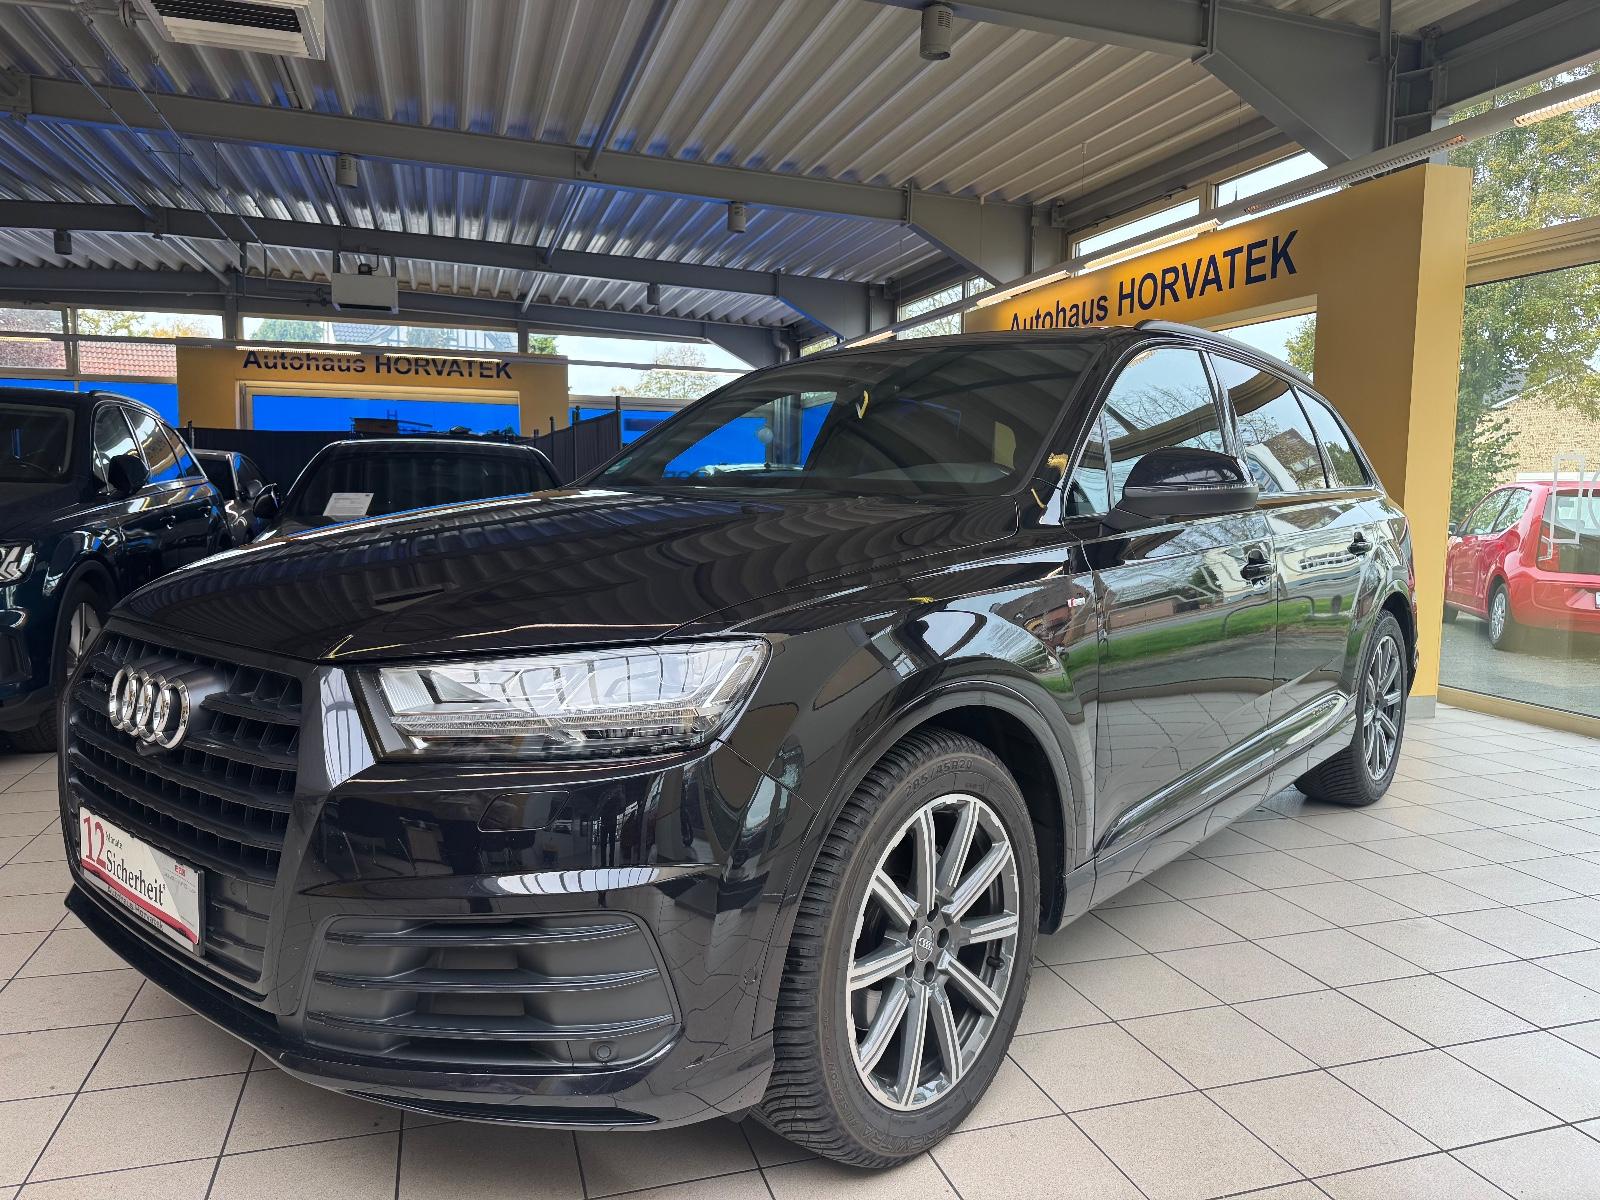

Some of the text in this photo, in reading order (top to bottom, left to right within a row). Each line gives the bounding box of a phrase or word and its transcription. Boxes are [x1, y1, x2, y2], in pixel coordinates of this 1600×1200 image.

[1010, 229, 1299, 331] Autohaus HORVATEK
[242, 350, 513, 380] Autohaus HORVATEK
[83, 815, 107, 869] 12
